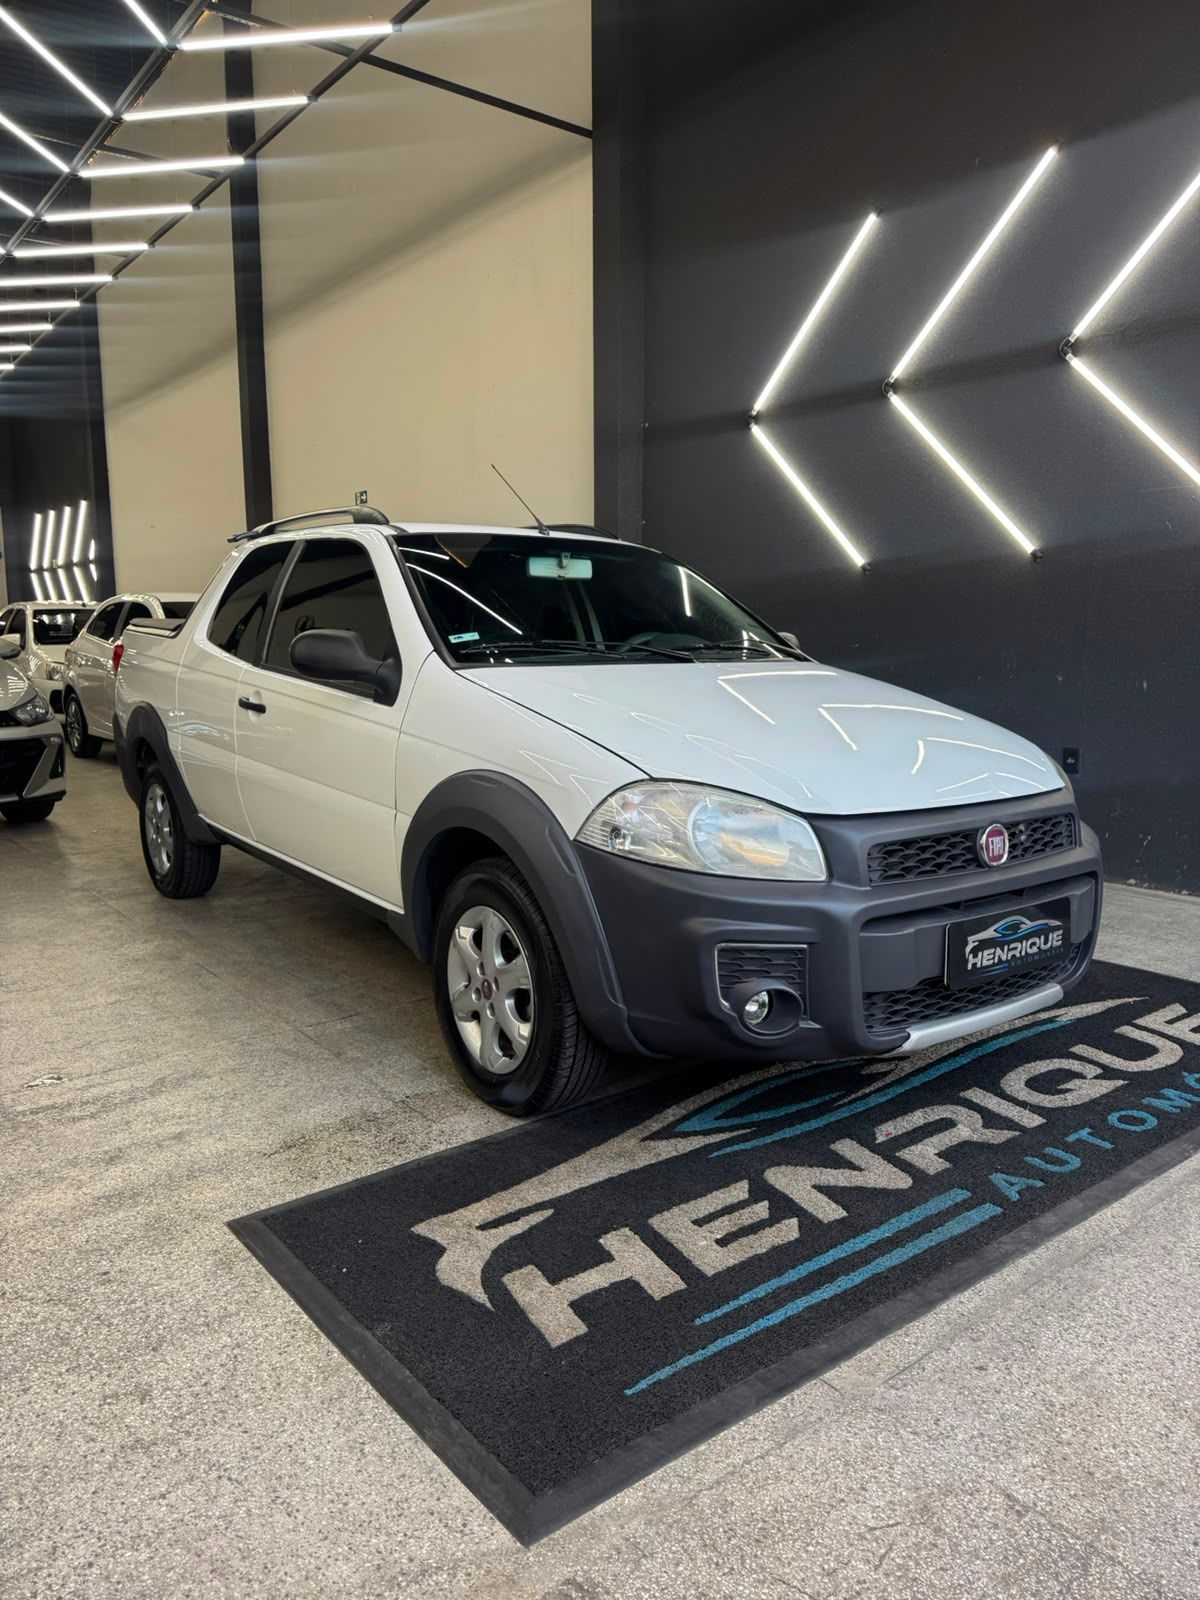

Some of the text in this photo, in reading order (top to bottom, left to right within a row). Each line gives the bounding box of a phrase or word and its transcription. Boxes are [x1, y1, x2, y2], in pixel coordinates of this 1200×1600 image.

[988, 836, 1004, 857] FIAT
[967, 930, 1063, 970] HENRIQUE
[502, 1003, 1200, 1348] HENRIQUE
